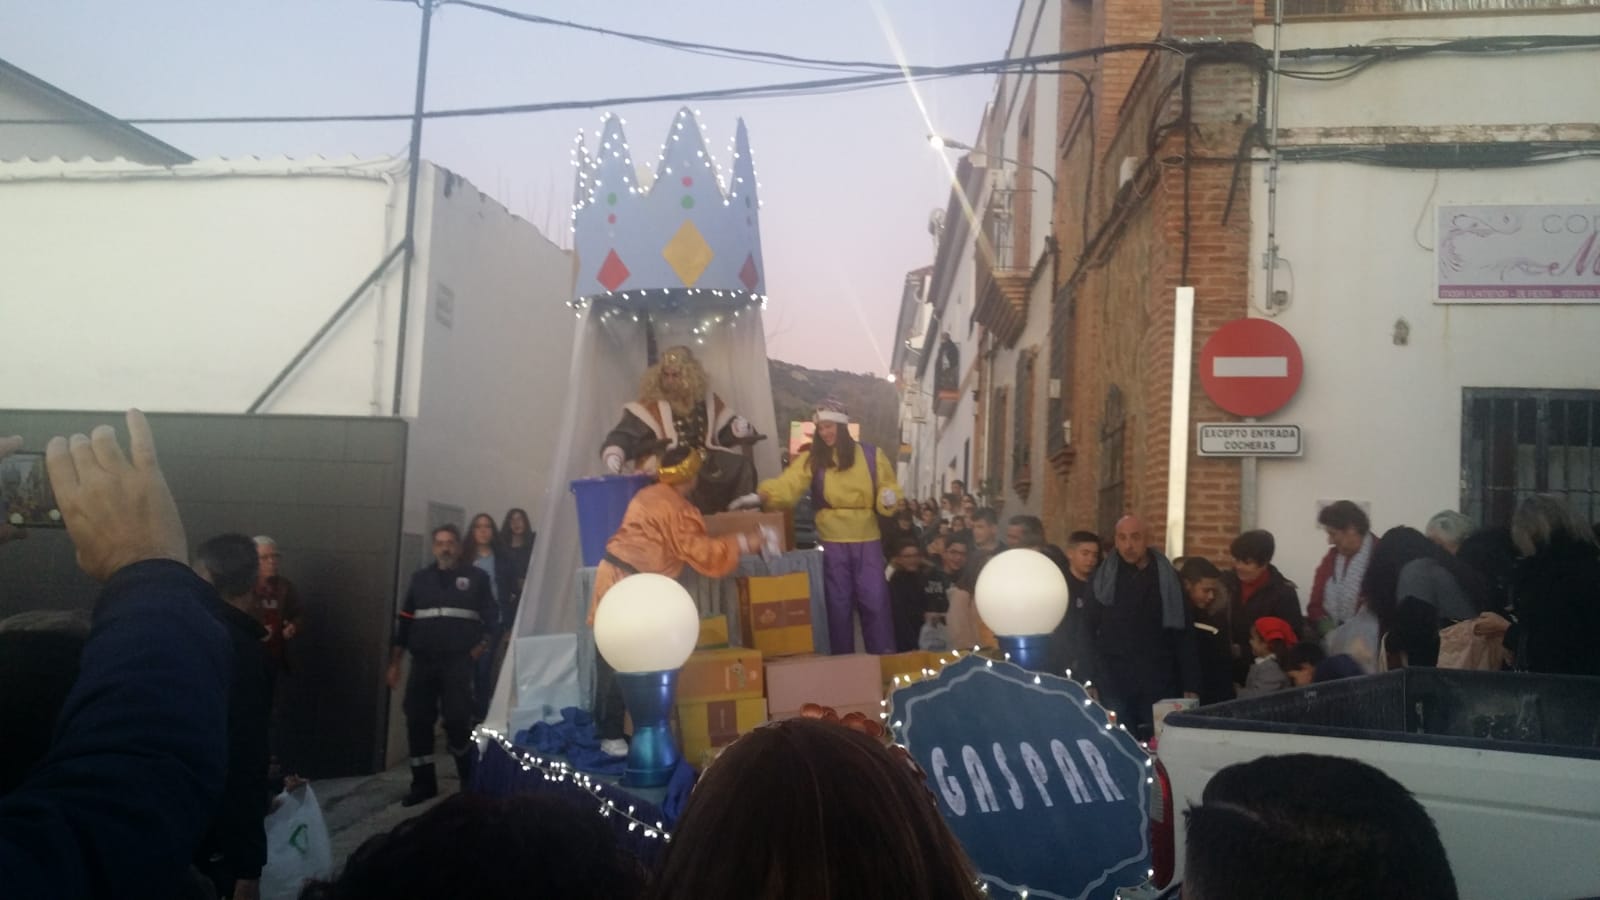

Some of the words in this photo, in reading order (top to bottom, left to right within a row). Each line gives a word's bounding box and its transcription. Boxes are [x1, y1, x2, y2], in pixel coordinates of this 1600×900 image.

[1204, 429, 1248, 438] EXCEPTO
[1250, 429, 1296, 438] ENTRADA
[1224, 441, 1276, 450] COCHERAS
[931, 739, 1125, 817] GASPAR
